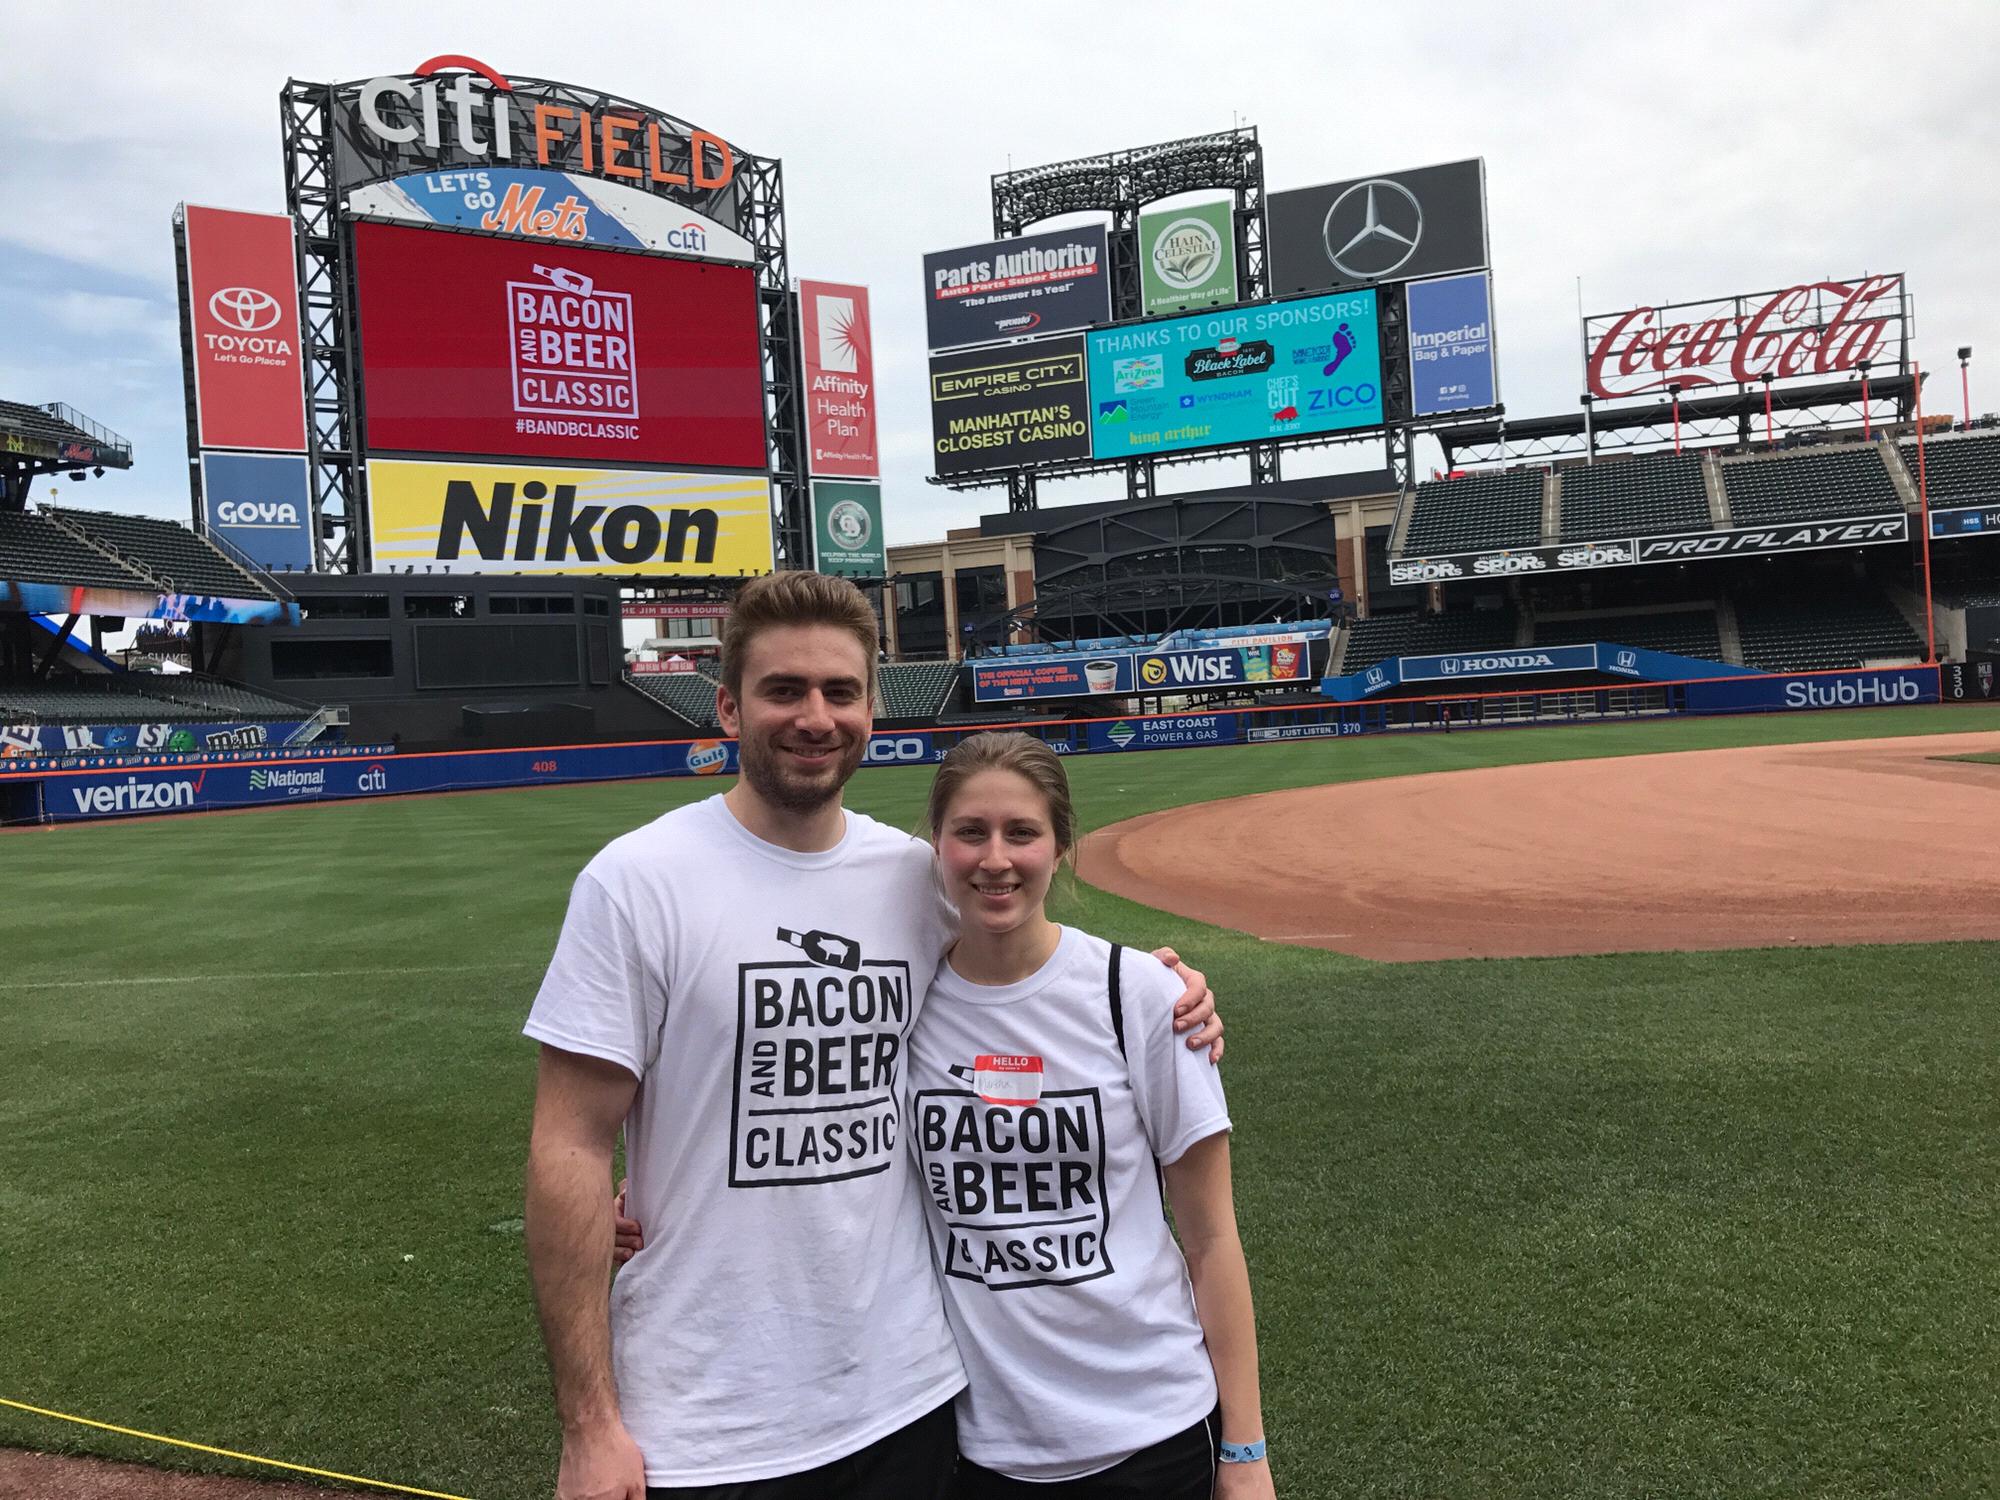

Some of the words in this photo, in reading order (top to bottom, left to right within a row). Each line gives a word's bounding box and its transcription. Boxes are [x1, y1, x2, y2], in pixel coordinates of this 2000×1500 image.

[359, 72, 512, 159] citi
[534, 103, 735, 190] FIELD
[424, 172, 491, 194] LET'S
[464, 192, 495, 210] GO
[481, 183, 588, 241] Mets
[667, 224, 706, 252] citi
[1169, 235, 1202, 249] HAIN
[1154, 240, 1216, 261] CELESTIAL
[934, 261, 991, 289] Parts
[994, 243, 1097, 280] Authority
[941, 287, 970, 298] Auto
[972, 281, 1006, 292] Parts
[1008, 275, 1047, 287] Super
[1050, 267, 1093, 279] Stores
[987, 291, 1030, 305] Answer
[1031, 289, 1043, 297] Is
[1157, 294, 1189, 304] Healthier
[1190, 292, 1205, 300] Way
[1206, 289, 1214, 297] of
[517, 292, 624, 332] BACON
[1096, 328, 1170, 354] THANKS
[1177, 324, 1201, 342] TO
[1207, 317, 1248, 338] OUR
[1255, 298, 1369, 330] SPONSORS!
[1412, 322, 1486, 347] Imperial
[204, 333, 292, 356] TOYOTA
[520, 328, 538, 364] AND
[540, 329, 629, 371] BEER
[1415, 350, 1438, 361] Bag
[1440, 347, 1450, 358] &
[1452, 344, 1487, 356] Paper
[214, 353, 237, 363] Let's
[239, 355, 253, 364] Go
[254, 355, 287, 367] Places
[1193, 358, 1232, 374] Black
[1232, 351, 1267, 369] Label
[941, 371, 1021, 393] EMPIRE
[1025, 363, 1074, 380] CITY
[1116, 368, 1162, 383] AriZona
[1216, 369, 1244, 377] BACON
[1266, 375, 1299, 390] CHEF'S
[522, 378, 630, 409] CLASSIC
[812, 376, 869, 399] Affinity
[983, 383, 1032, 397] CASINO
[1197, 390, 1253, 403] WYNDHAM
[1267, 387, 1299, 410] CUT
[1308, 383, 1376, 411] ZICO
[817, 398, 866, 418] Health
[949, 404, 1072, 435] MANHATTAN'S
[516, 418, 640, 440] #BANDBCLASSIC
[827, 418, 859, 437] Plan
[936, 430, 1015, 453] CLOSEST
[1018, 420, 1086, 443] CASINO
[1129, 431, 1161, 445] king
[1165, 424, 1212, 443] arthur
[217, 501, 298, 524] GOYA
[435, 479, 720, 564] Nikon
[1641, 536, 1730, 558] PRO
[1731, 521, 1902, 549] PLAYER
[1252, 635, 1293, 644] PAVILION
[1169, 655, 1232, 682] WISE
[1461, 654, 1554, 671] HONDA
[1609, 664, 1640, 676] HONDA
[979, 680, 990, 688] OF
[1032, 676, 1054, 684] YORK
[1364, 679, 1392, 694] HONDA
[1785, 676, 1920, 708] StubHub
[1142, 719, 1175, 731] EAST
[1177, 717, 1217, 729] COAST
[1281, 726, 1302, 736] JUST
[1303, 725, 1334, 736] LISTEN.
[1343, 723, 1361, 734] 370
[1143, 732, 1184, 743] POWER
[1186, 731, 1194, 741] &
[1195, 729, 1218, 740] GAS
[532, 760, 557, 772] 408
[690, 748, 724, 766] Gulf
[267, 768, 324, 787] National
[358, 768, 386, 791] citi
[72, 776, 195, 813] verizon
[288, 787, 300, 795] Car
[301, 785, 323, 794] Rental
[754, 974, 903, 1029] BACON
[750, 1040, 778, 1098] AND
[783, 1032, 901, 1097] BEER
[992, 1057, 1029, 1066] HELLO
[745, 1112, 896, 1170] CLASSIC
[923, 1105, 1090, 1154] BACON
[929, 1162, 953, 1213] AND
[953, 1161, 1096, 1215] BEER
